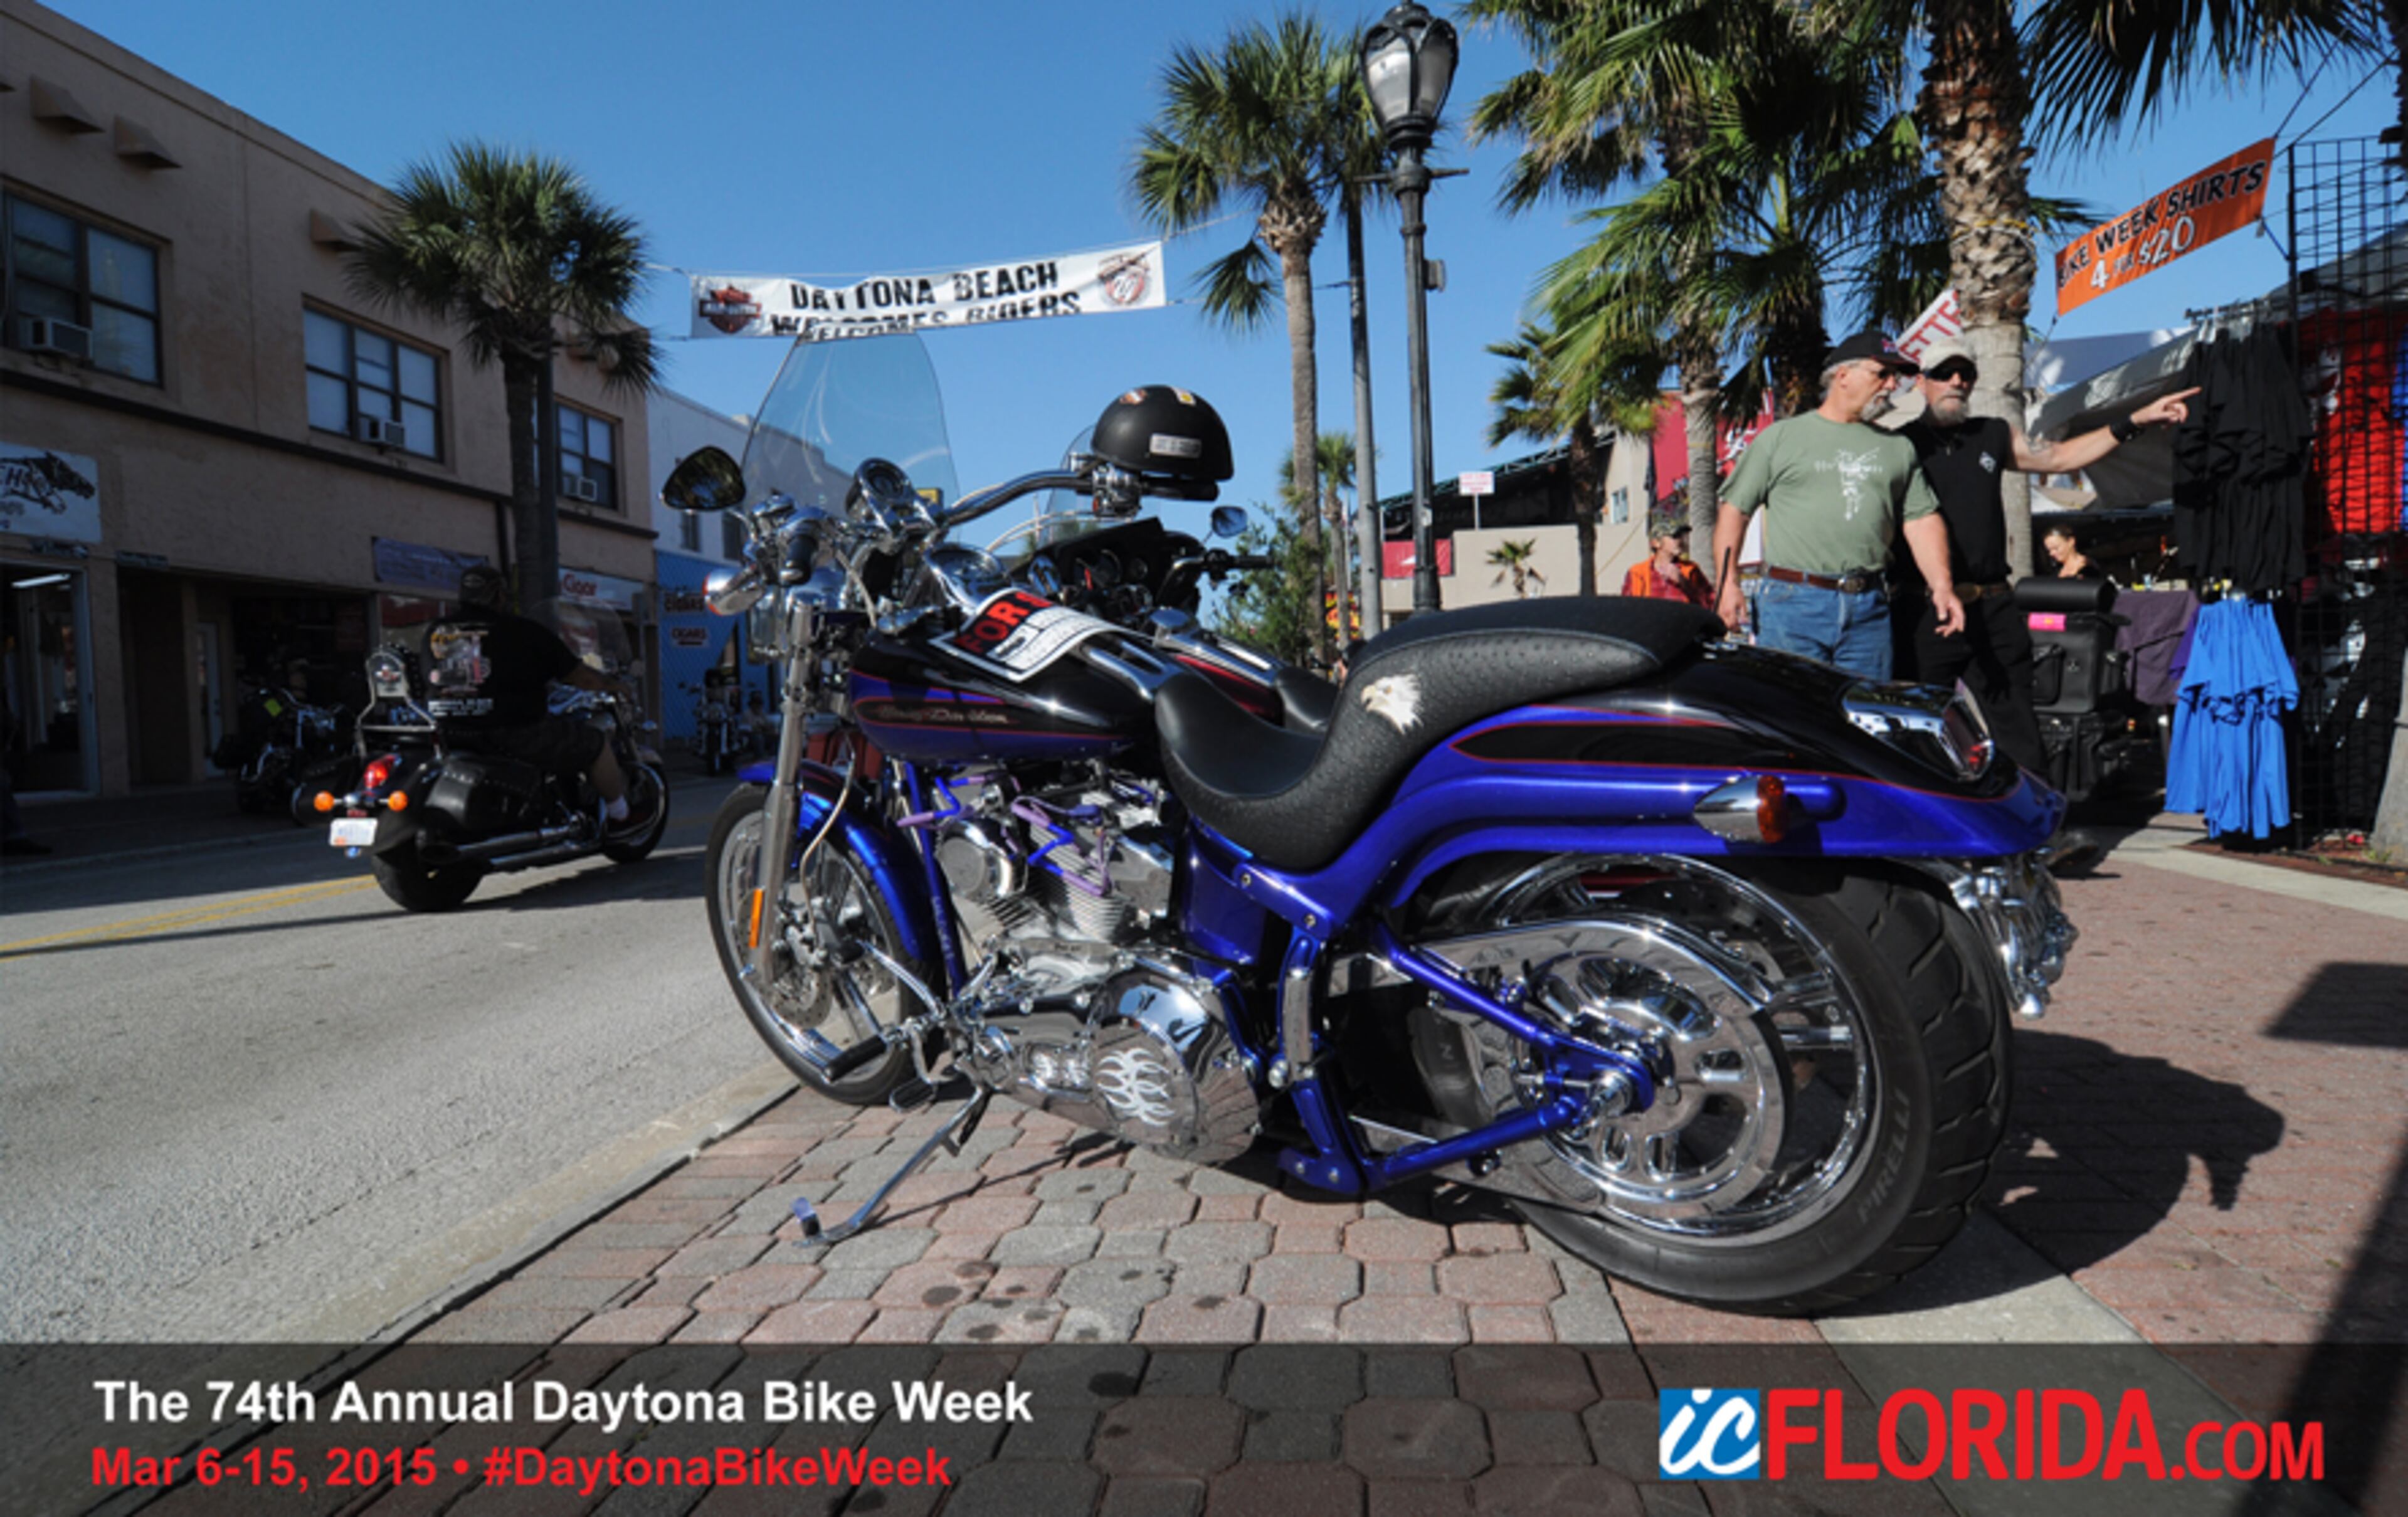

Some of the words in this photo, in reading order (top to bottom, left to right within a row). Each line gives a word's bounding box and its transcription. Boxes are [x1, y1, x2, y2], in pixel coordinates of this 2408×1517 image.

[2096, 200, 2159, 253] WEEK
[2166, 160, 2266, 218] SHIRTS
[790, 278, 936, 310] DAYTONA
[954, 261, 1059, 302] BEACH
[2090, 260, 2110, 288] 4
[2139, 216, 2195, 265] $20
[952, 600, 1031, 654] FOR
[1857, 1087, 1910, 1224] PIRELLI
